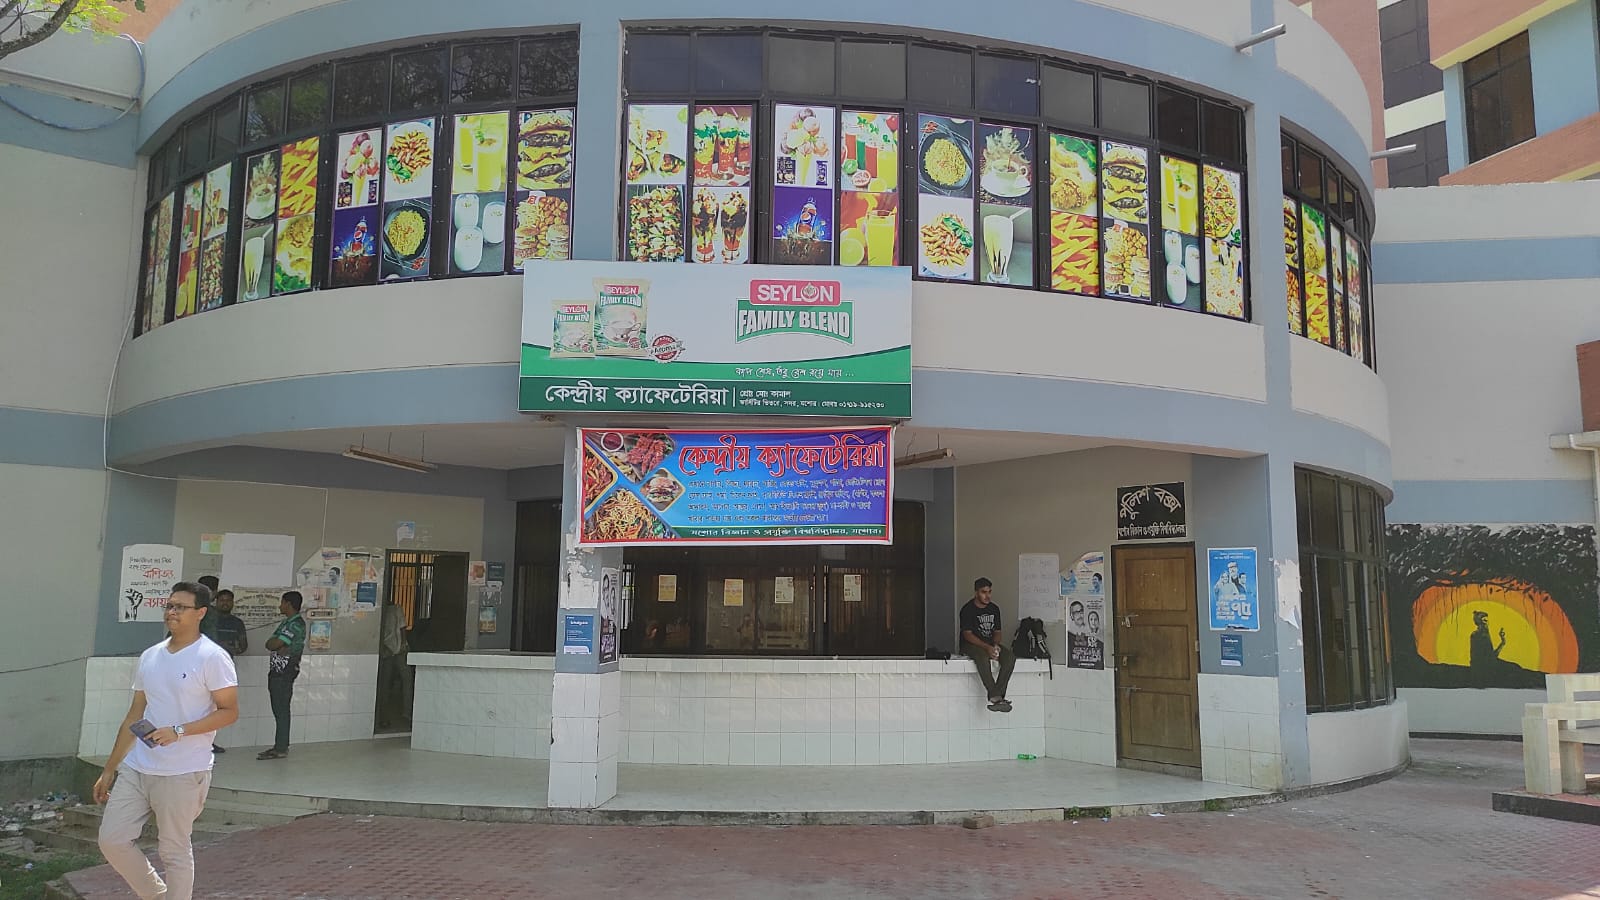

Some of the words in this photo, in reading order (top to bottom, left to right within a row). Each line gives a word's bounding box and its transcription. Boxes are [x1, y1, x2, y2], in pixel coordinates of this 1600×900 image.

[757, 281, 834, 302] SEYLON
[739, 309, 795, 337] FAMILY
[799, 311, 850, 338] BLEND
[545, 379, 609, 404] কেন্দ্রীয়
[613, 383, 730, 406] ক্যাফেটেরিয়া
[679, 434, 750, 475] কেন্দ্রীয়
[755, 433, 886, 477] ক্যাফেটেরিয়া
